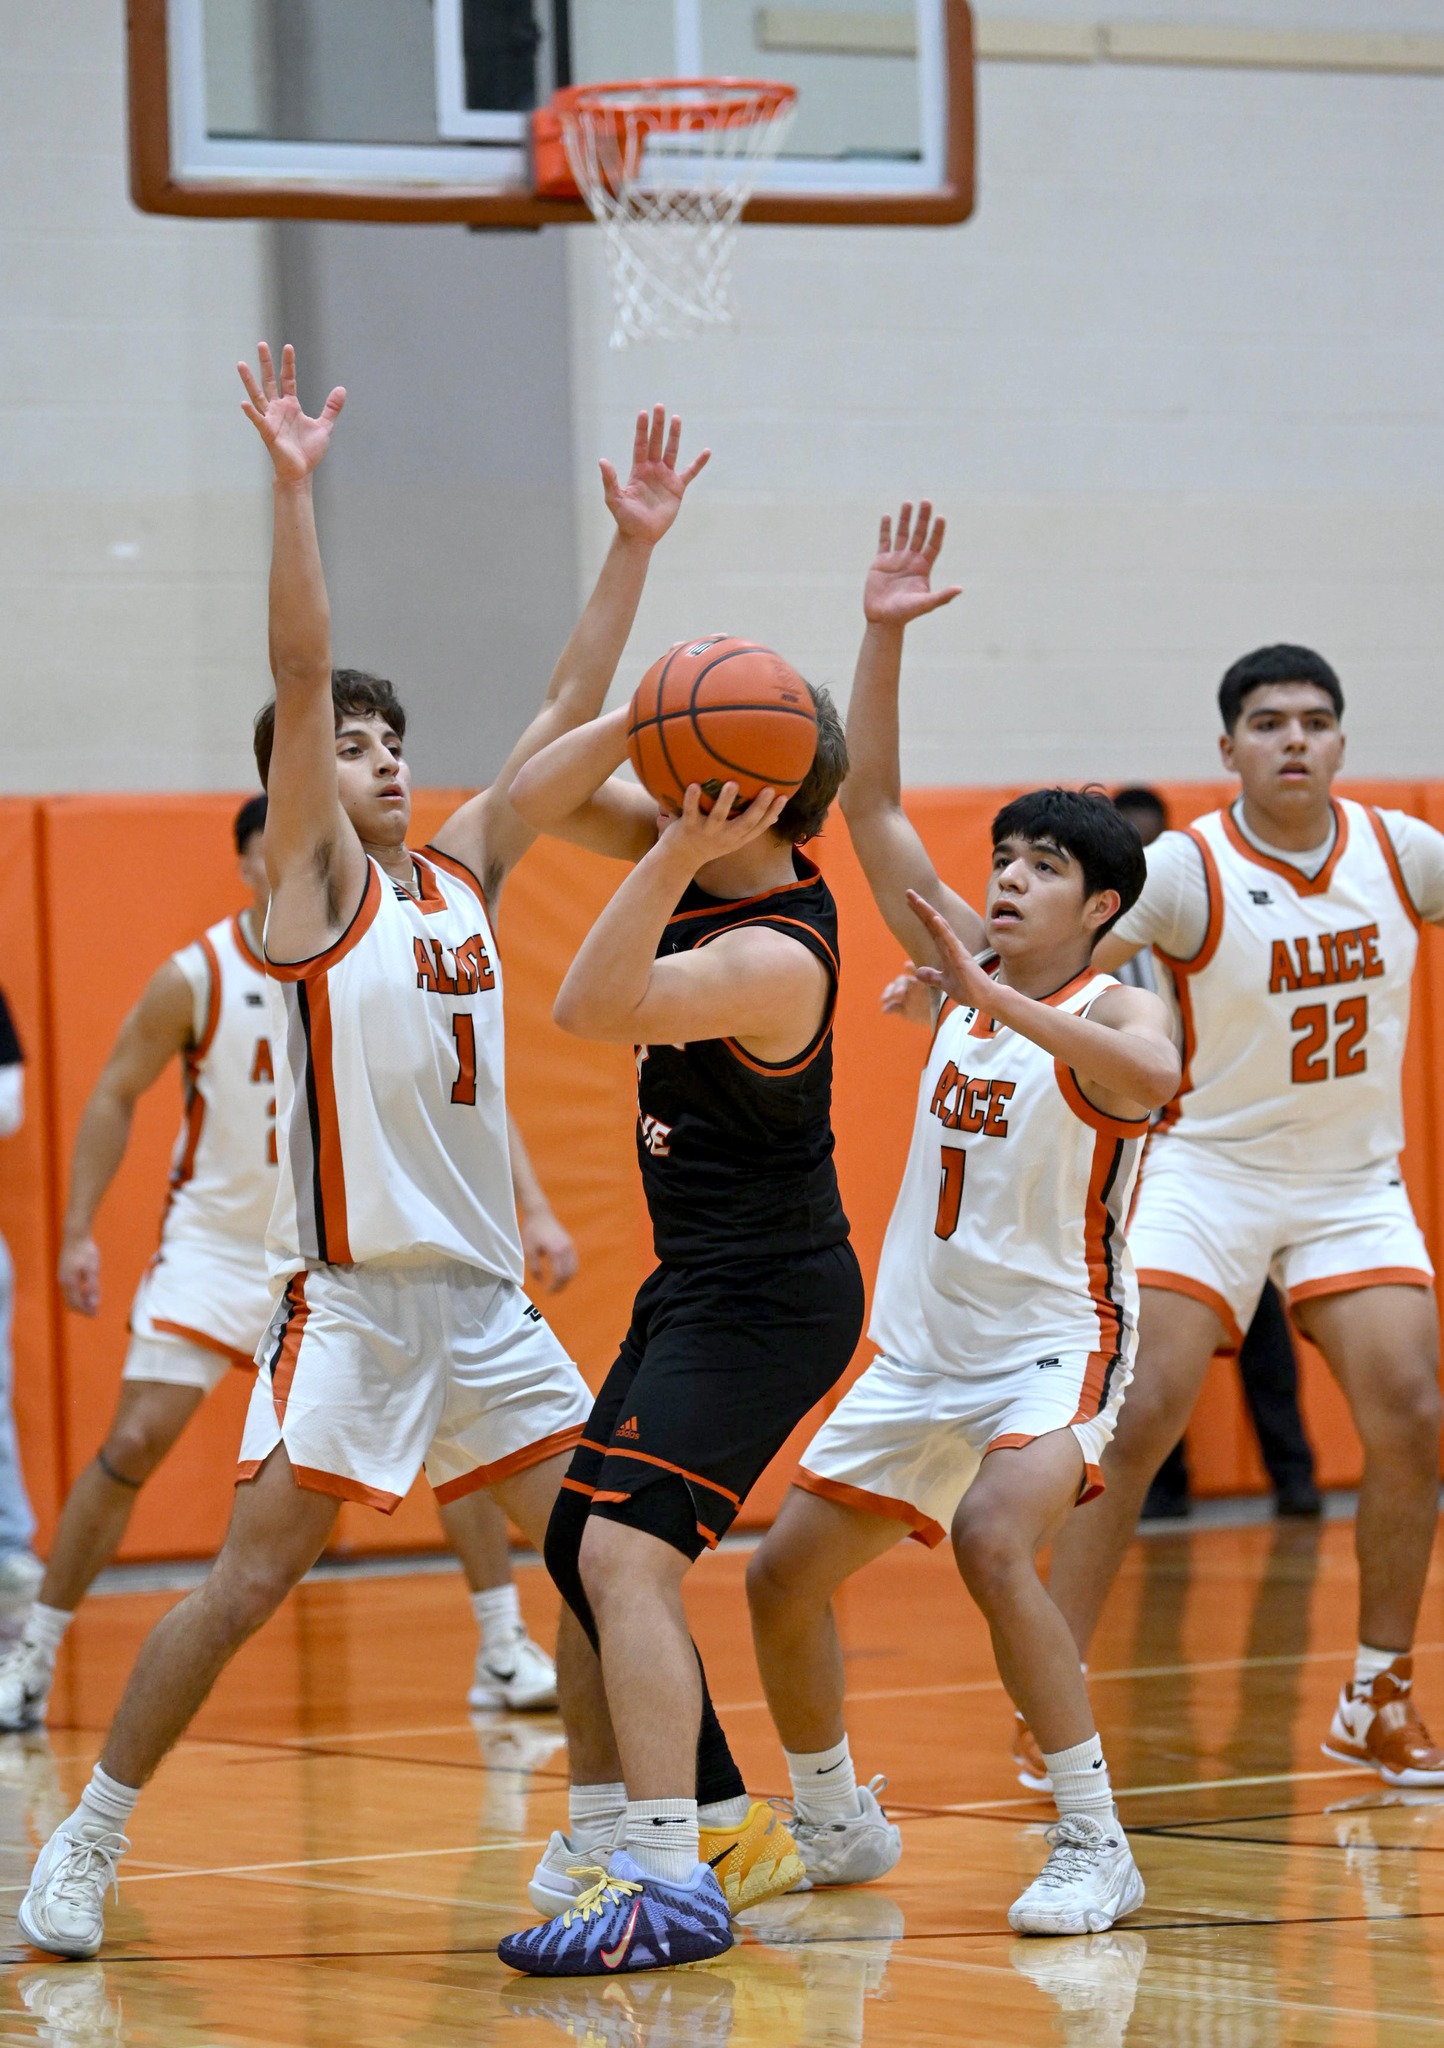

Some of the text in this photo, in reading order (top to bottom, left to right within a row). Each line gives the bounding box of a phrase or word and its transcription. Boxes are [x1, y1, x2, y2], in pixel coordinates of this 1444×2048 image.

[1268, 922, 1385, 994] ALICE
[451, 1013, 477, 1106] 1
[1291, 995, 1368, 1083] 22
